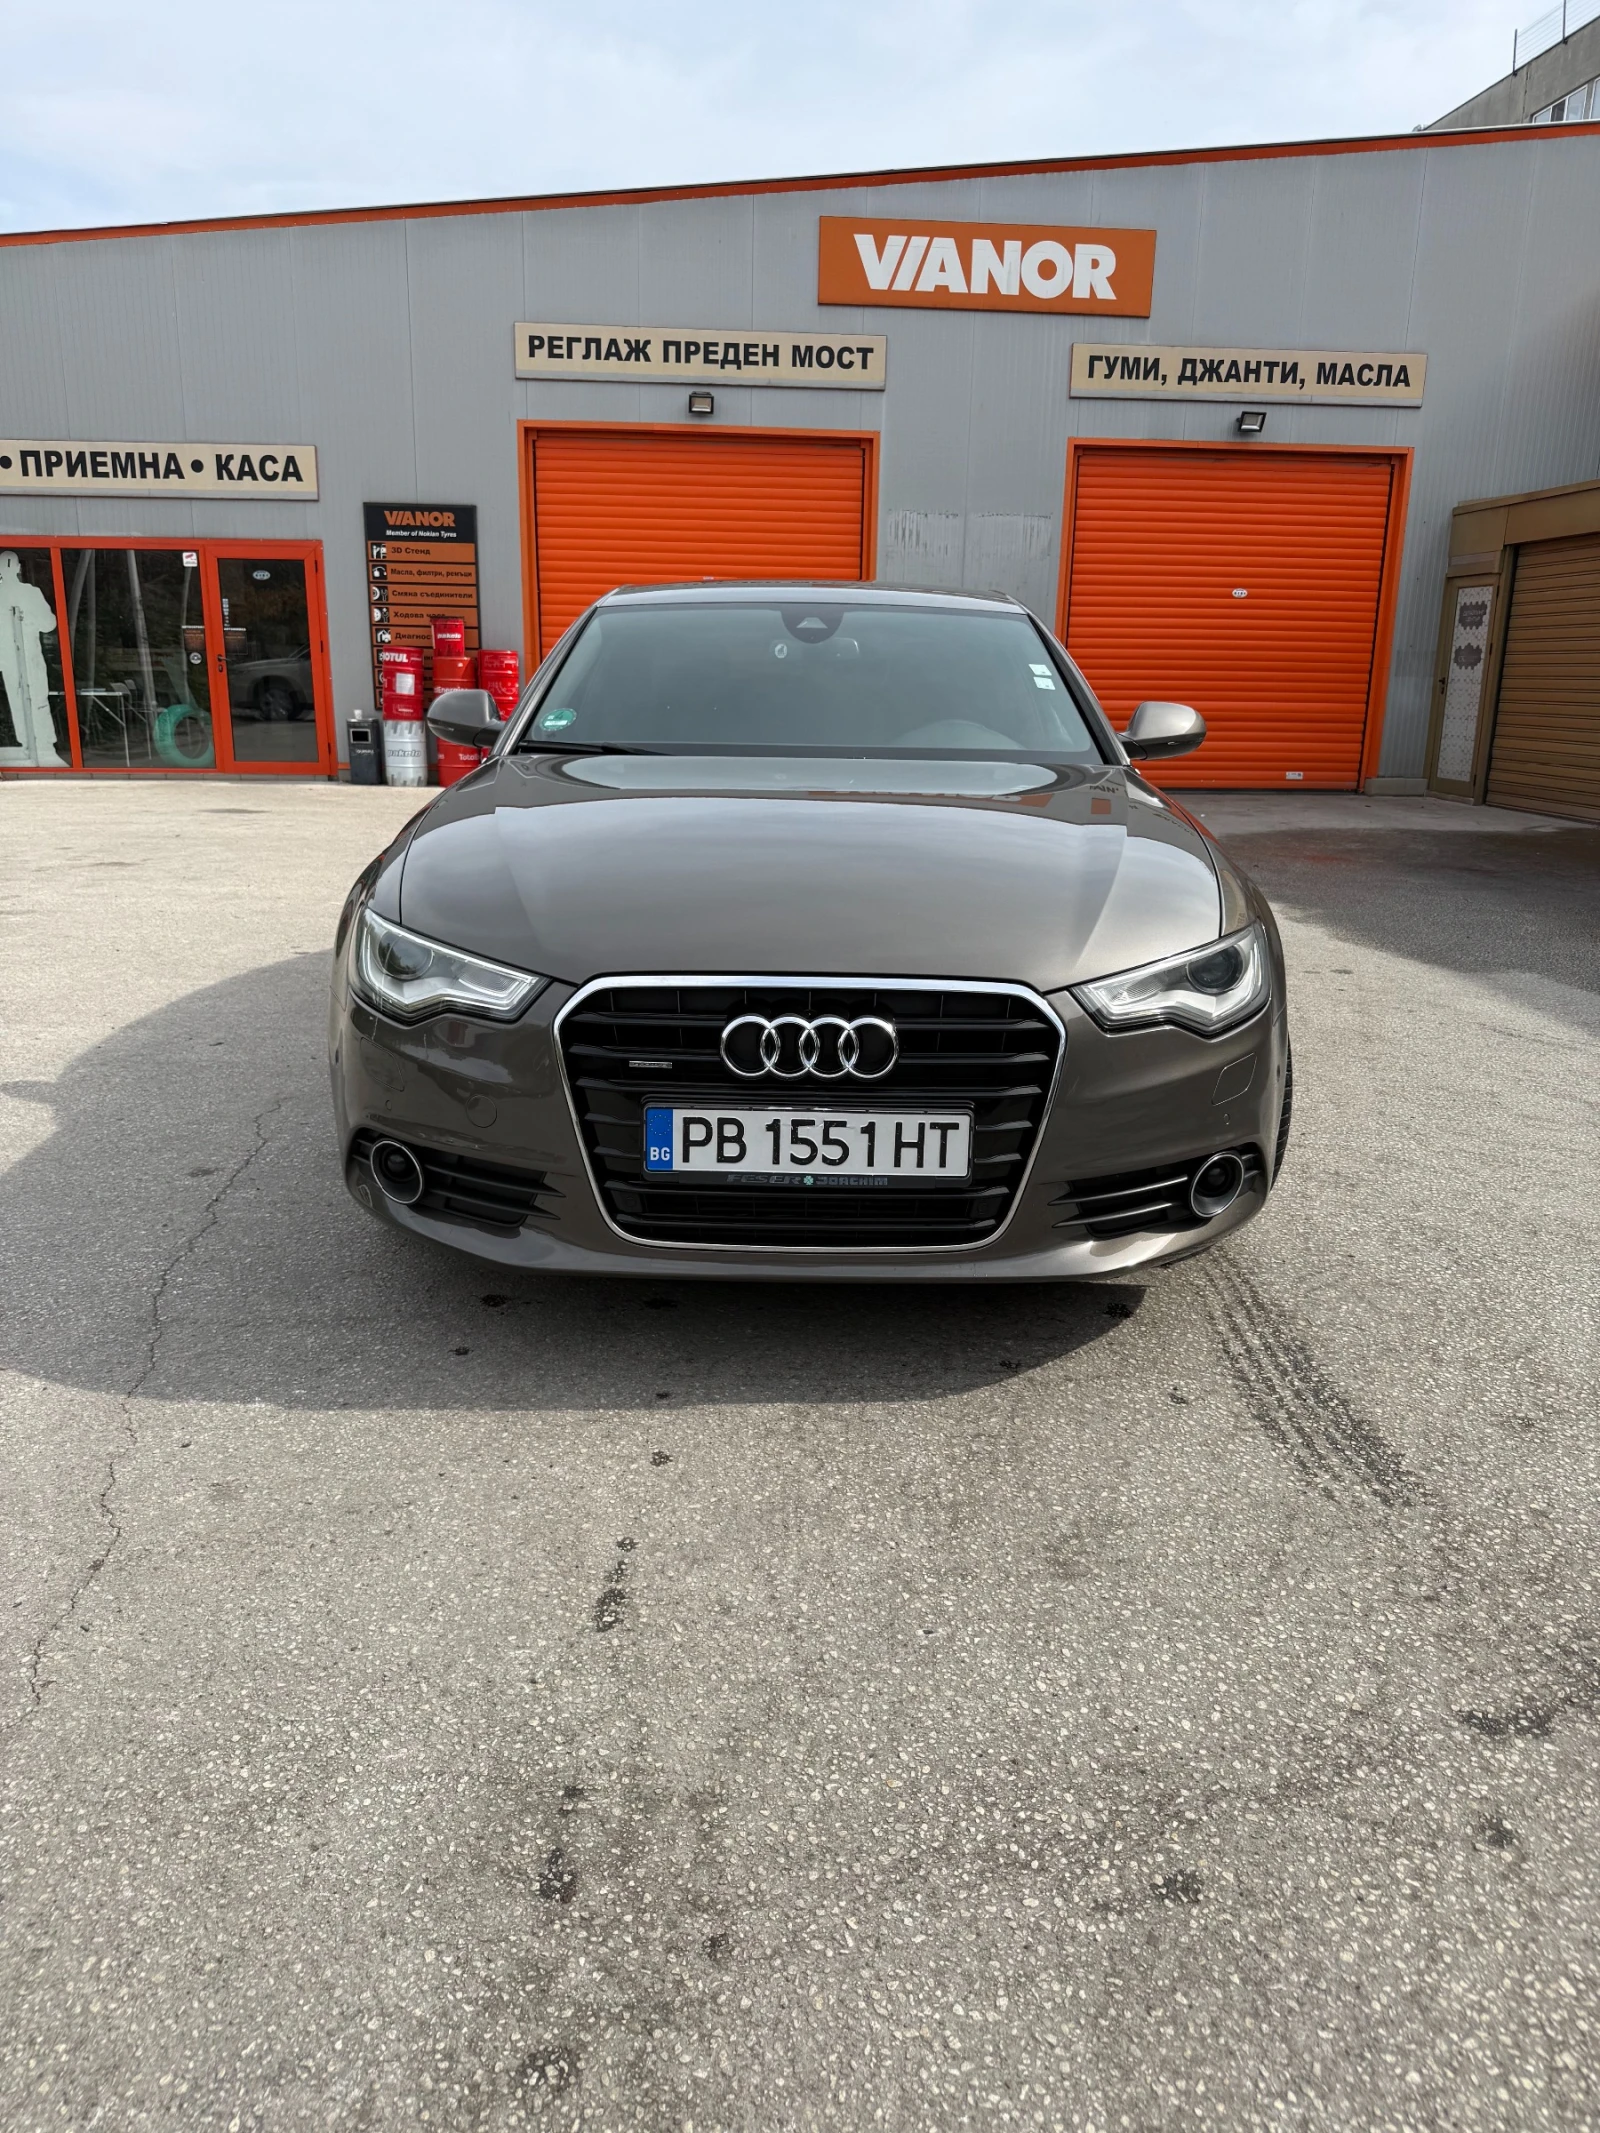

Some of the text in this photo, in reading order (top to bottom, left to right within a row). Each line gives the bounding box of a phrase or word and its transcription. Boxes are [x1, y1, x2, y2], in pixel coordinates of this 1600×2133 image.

[853, 233, 1117, 300] VIANOR
[527, 335, 873, 371] РЕГЛАЖ ПРЕДЕН МОСТ
[1087, 355, 1411, 390] ГУМИ, ДЖАНТИ, МАСЛА
[19, 450, 304, 482] ПРИЕМНА КАСА
[384, 510, 456, 527] VIANOR
[440, 531, 457, 539] Tyres
[405, 547, 431, 555] Стенд
[390, 568, 415, 576] Масла,
[393, 611, 424, 619] Ходова
[383, 652, 408, 662] OTUL
[682, 1116, 960, 1169] PB 1551 HT
[650, 1146, 670, 1161] BG
[726, 1173, 888, 1186] FESER JOACHIM
